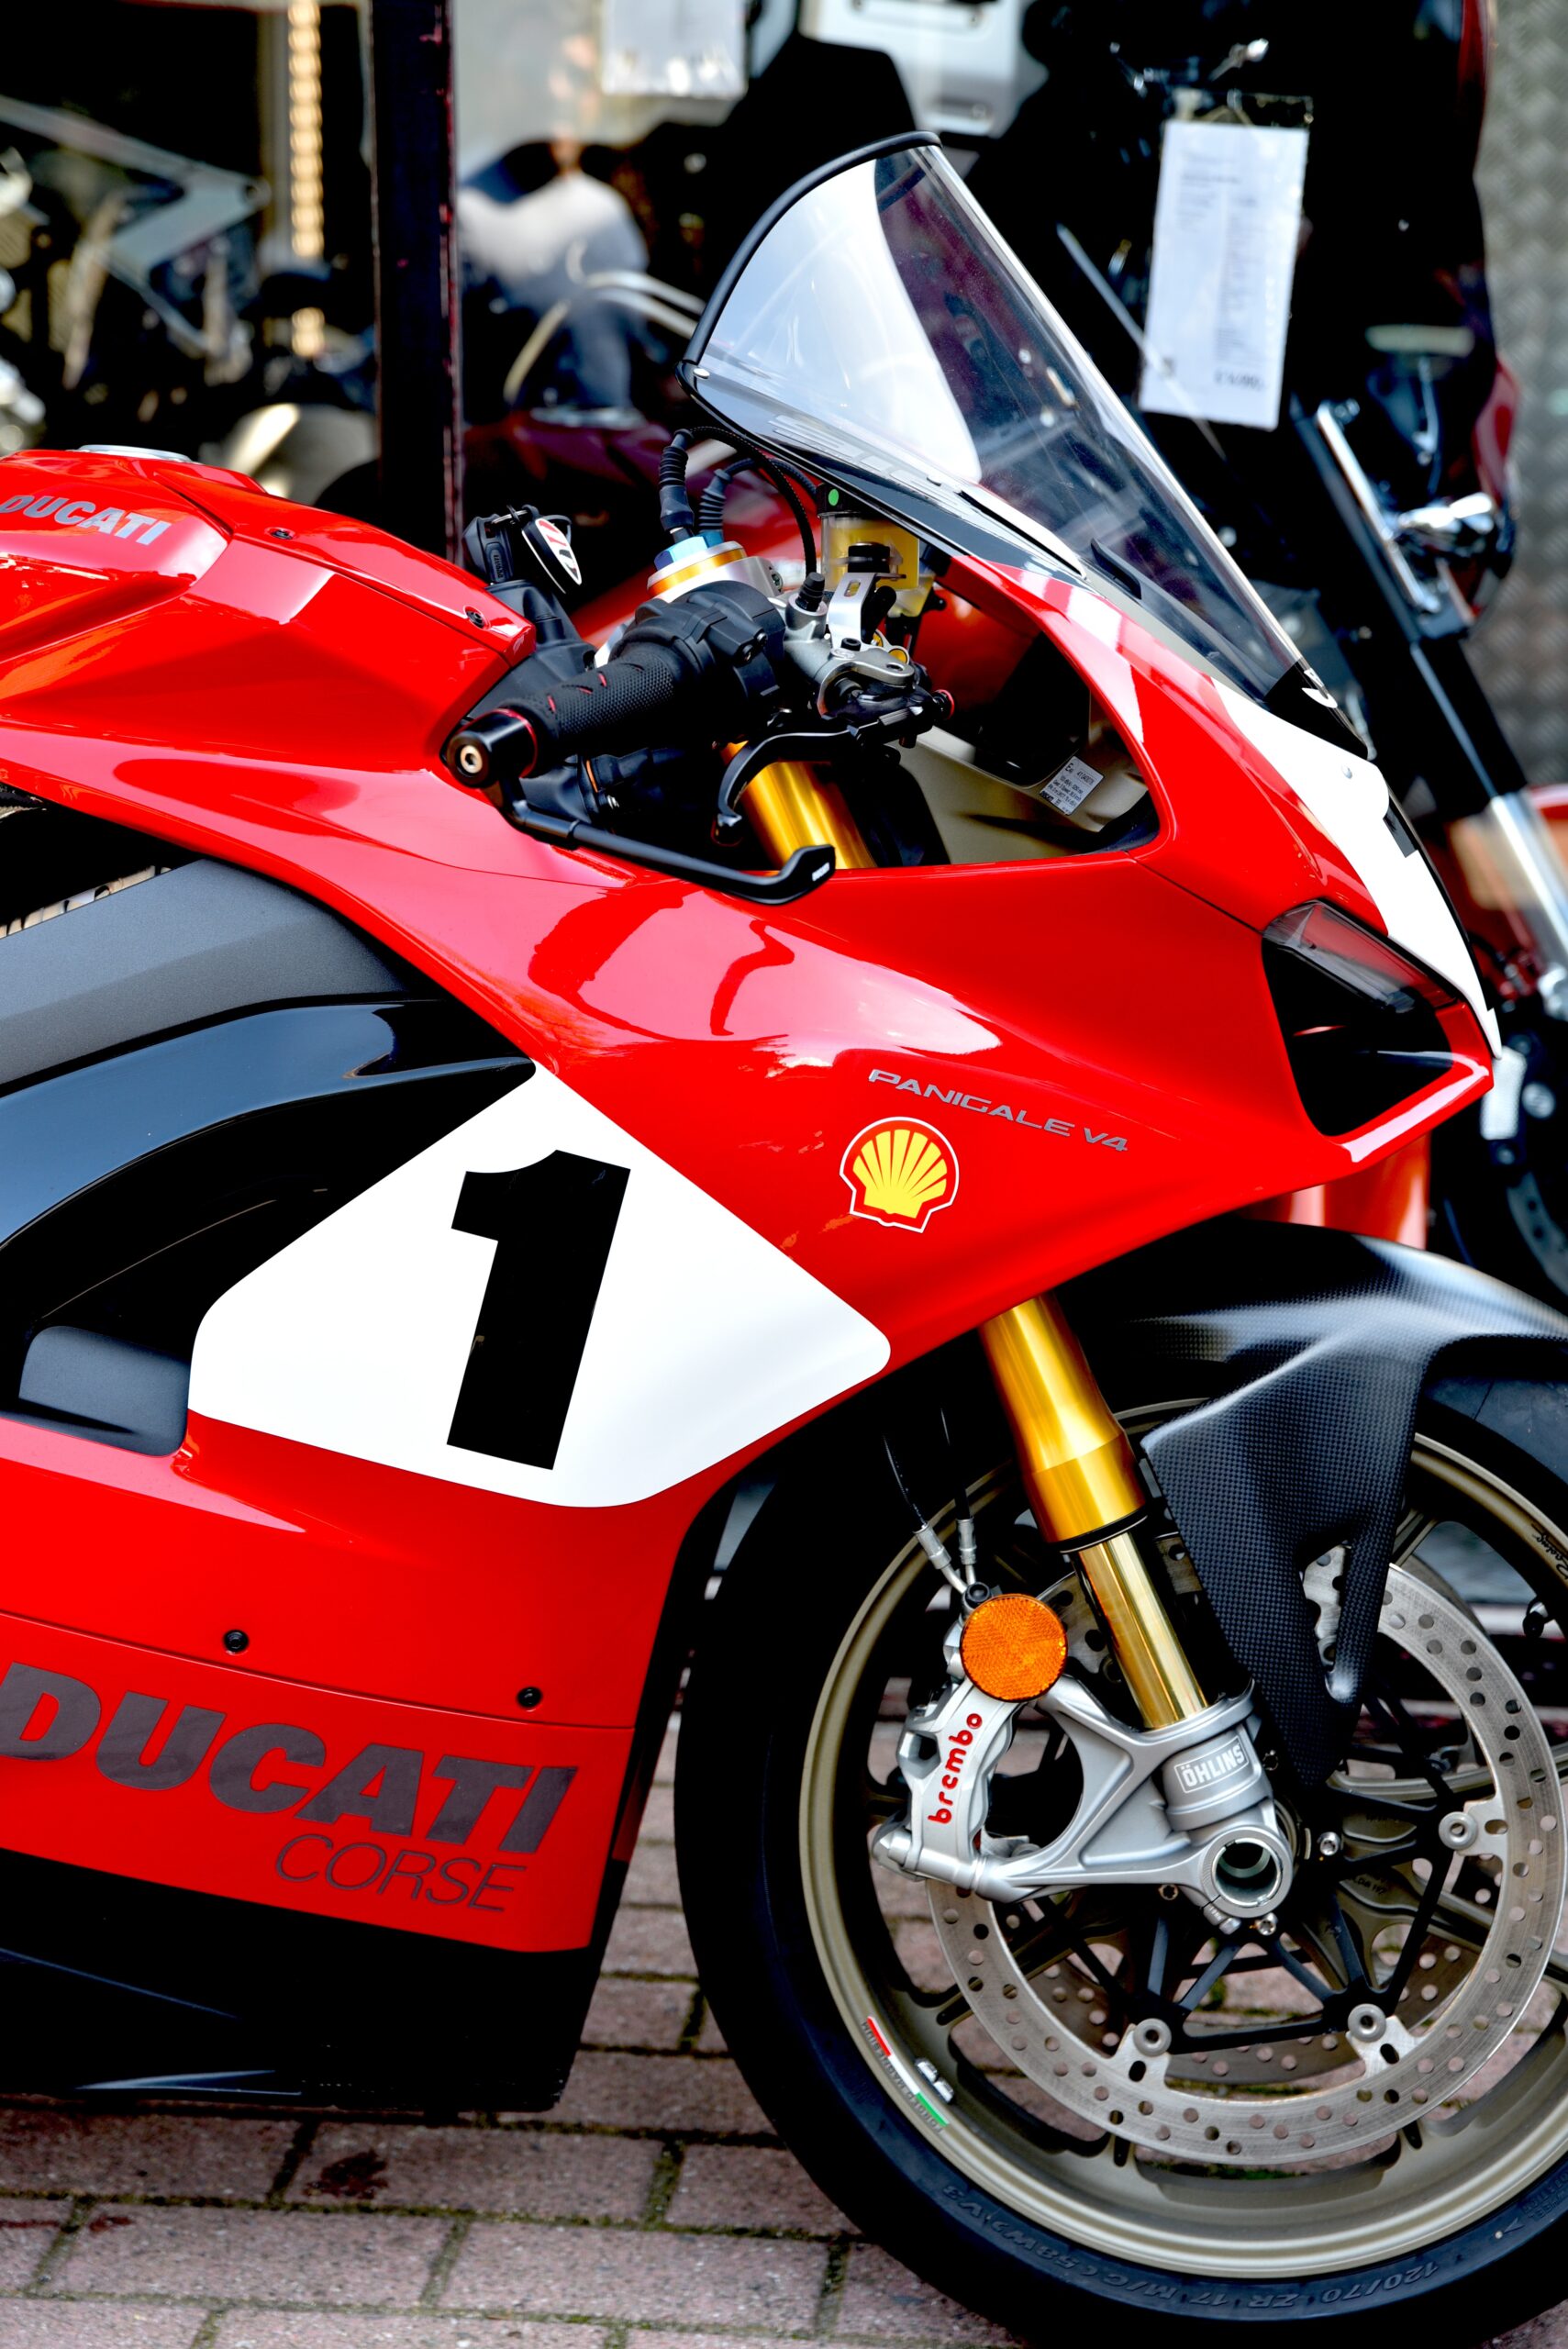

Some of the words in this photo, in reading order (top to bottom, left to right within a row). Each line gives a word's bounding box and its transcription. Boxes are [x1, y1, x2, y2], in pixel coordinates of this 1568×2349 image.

[0, 495, 172, 545] DUCATI
[868, 1069, 1075, 1137] PANIGALE
[1084, 1127, 1129, 1152] V4
[446, 1149, 631, 1471] 1
[0, 1662, 579, 1854] DUCATI
[928, 1713, 983, 1824] brembo
[1180, 1743, 1245, 1787] ÖHLINS
[275, 1834, 527, 1912] CORSE
[1189, 2291, 1229, 2307] 17
[1247, 2292, 1301, 2309] ZR
[1321, 2261, 1440, 2304] 120/70
